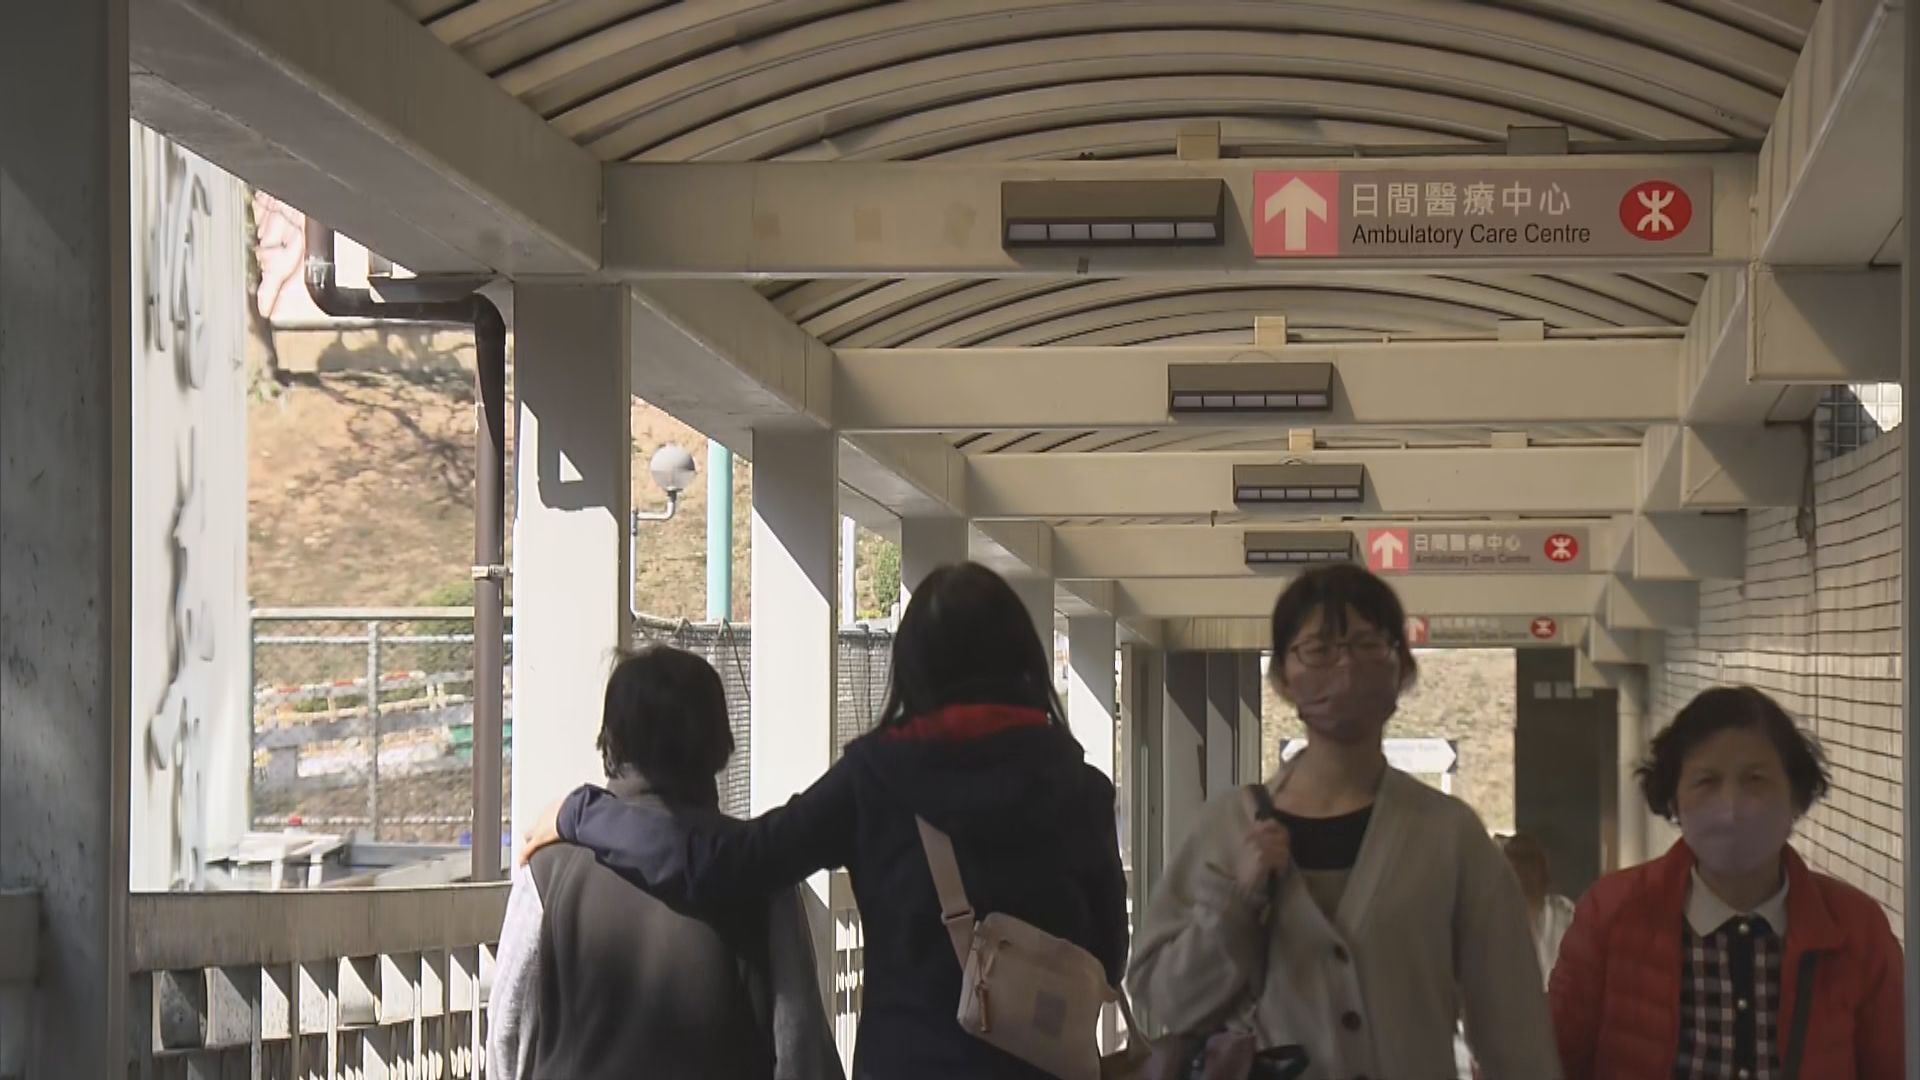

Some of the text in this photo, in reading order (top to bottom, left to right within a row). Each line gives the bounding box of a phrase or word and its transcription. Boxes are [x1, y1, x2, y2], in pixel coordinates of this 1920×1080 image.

[1352, 181, 1571, 217] 日間醫療中心
[1352, 224, 1591, 248] Ambulatory Care Centre
